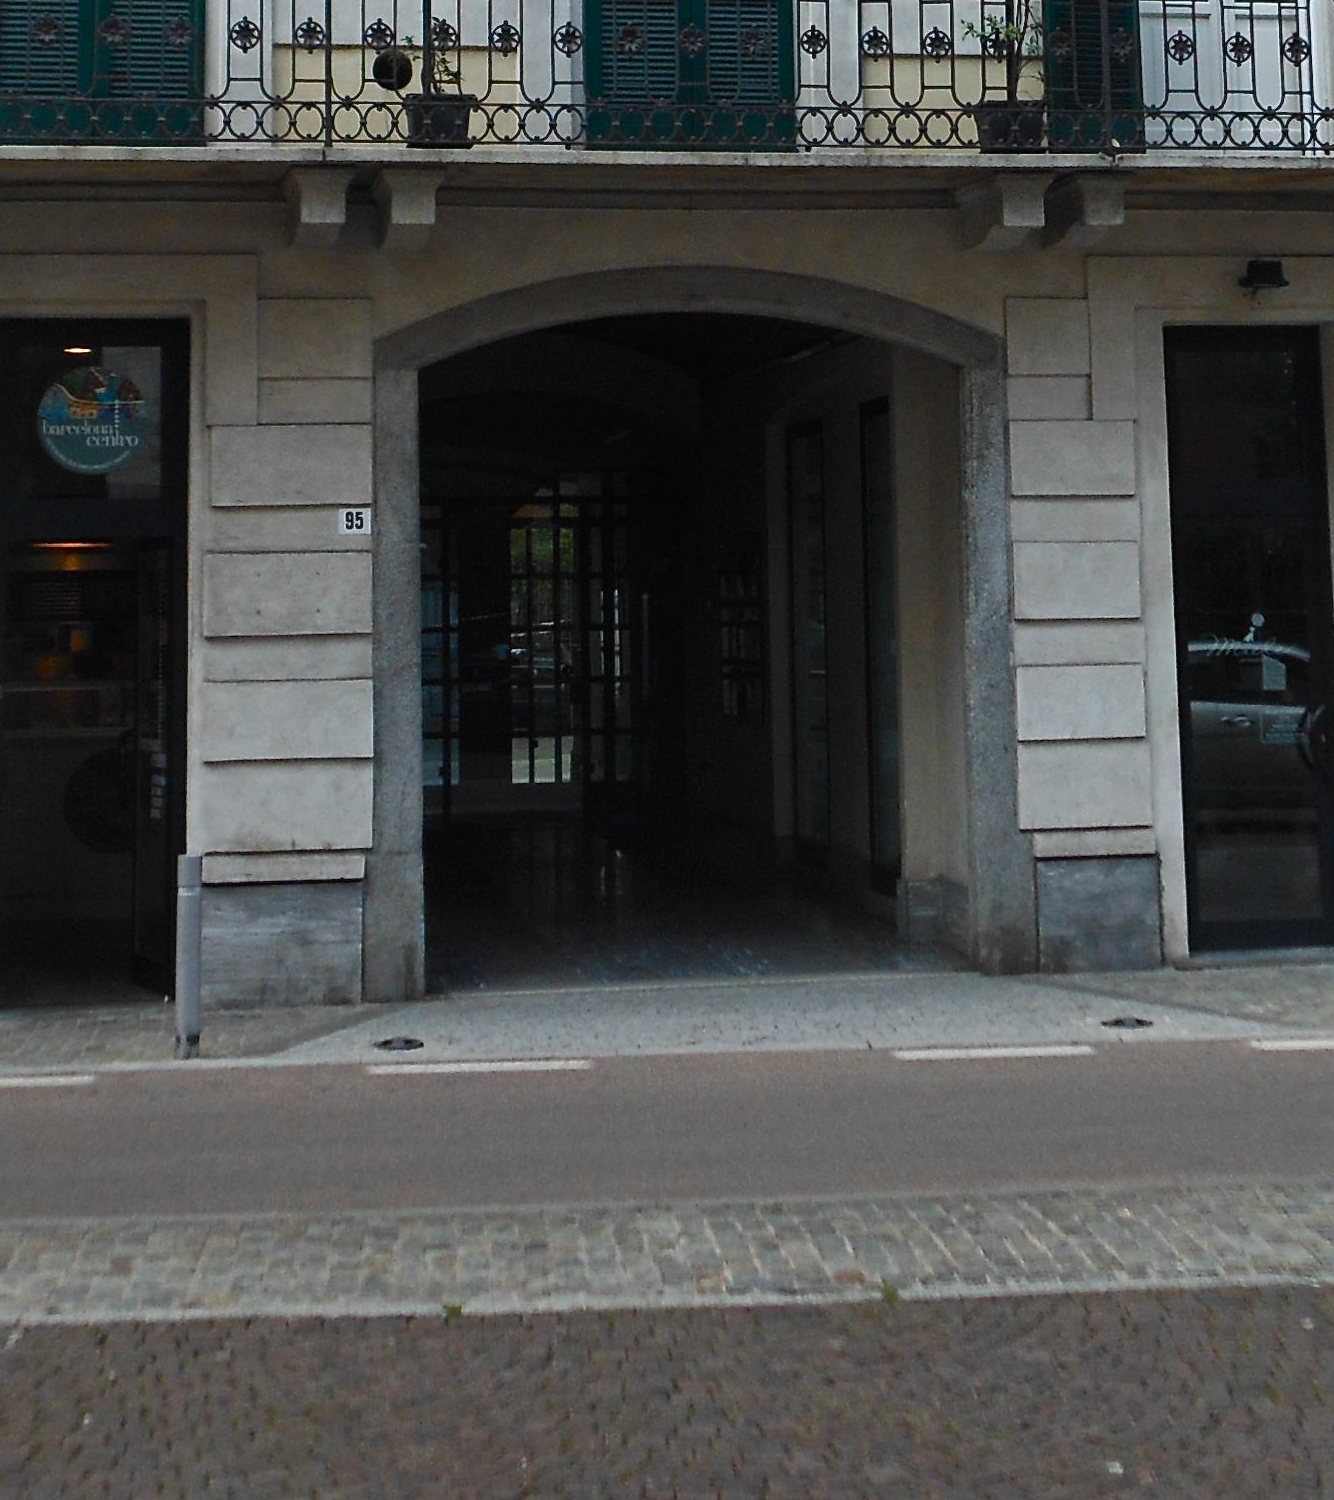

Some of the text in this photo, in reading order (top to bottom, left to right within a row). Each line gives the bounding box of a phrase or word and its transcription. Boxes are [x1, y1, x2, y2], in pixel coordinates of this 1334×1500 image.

[42, 419, 114, 436] barcelona
[85, 429, 139, 448] centro
[345, 511, 364, 530] 95
